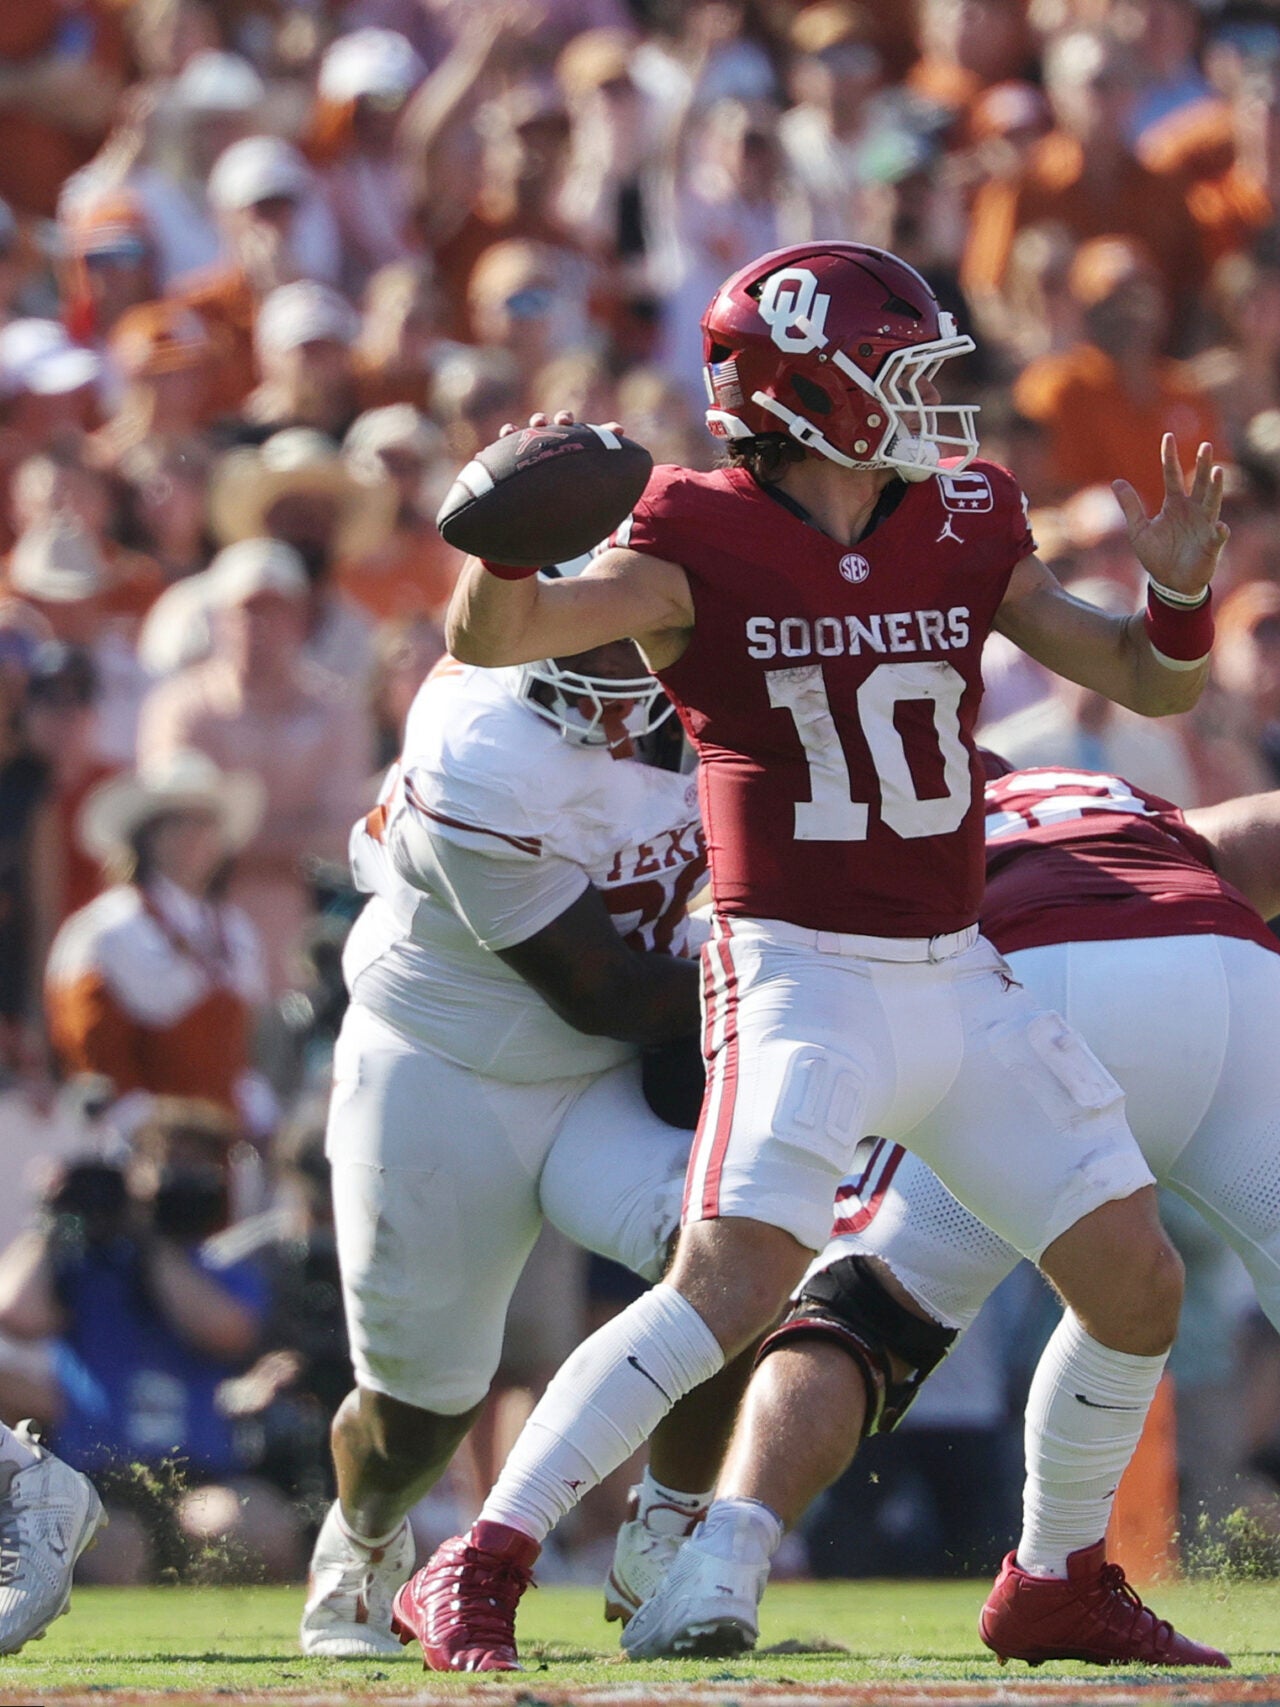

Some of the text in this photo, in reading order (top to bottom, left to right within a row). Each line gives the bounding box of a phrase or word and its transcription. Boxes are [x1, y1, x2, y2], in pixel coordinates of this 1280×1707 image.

[758, 267, 832, 354] OU
[841, 556, 868, 582] SEC
[746, 606, 970, 660] SOONERS
[764, 660, 973, 842] 10
